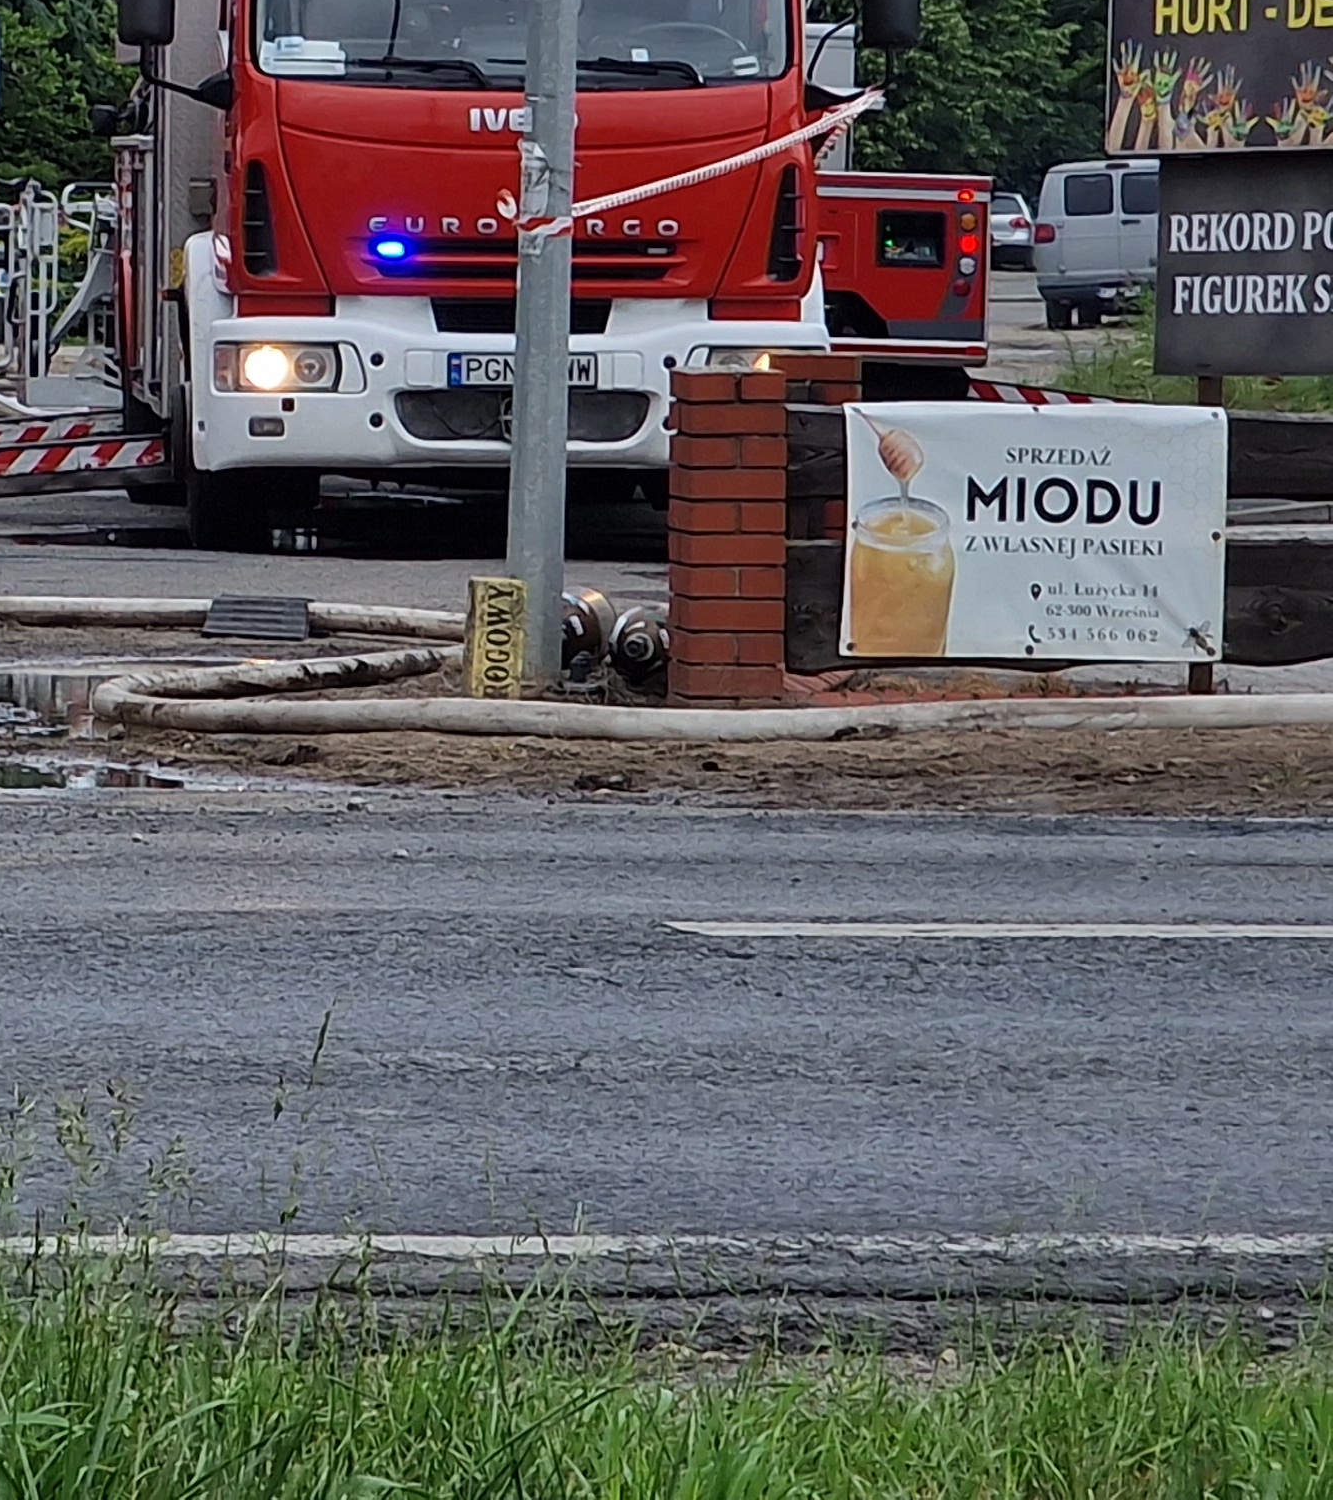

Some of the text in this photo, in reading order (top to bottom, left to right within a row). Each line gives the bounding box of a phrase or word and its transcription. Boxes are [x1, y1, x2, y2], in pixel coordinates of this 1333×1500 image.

[368, 216, 680, 237] EURORGO
[1169, 212, 1296, 252] REKORD
[1173, 274, 1333, 315] FIGUREK S
[966, 475, 1162, 526] MIODU
[965, 536, 977, 552] Z
[1083, 538, 1164, 557] PASIEKI
[1048, 582, 1068, 596] ul.
[1045, 603, 1159, 618] 62-300 Września
